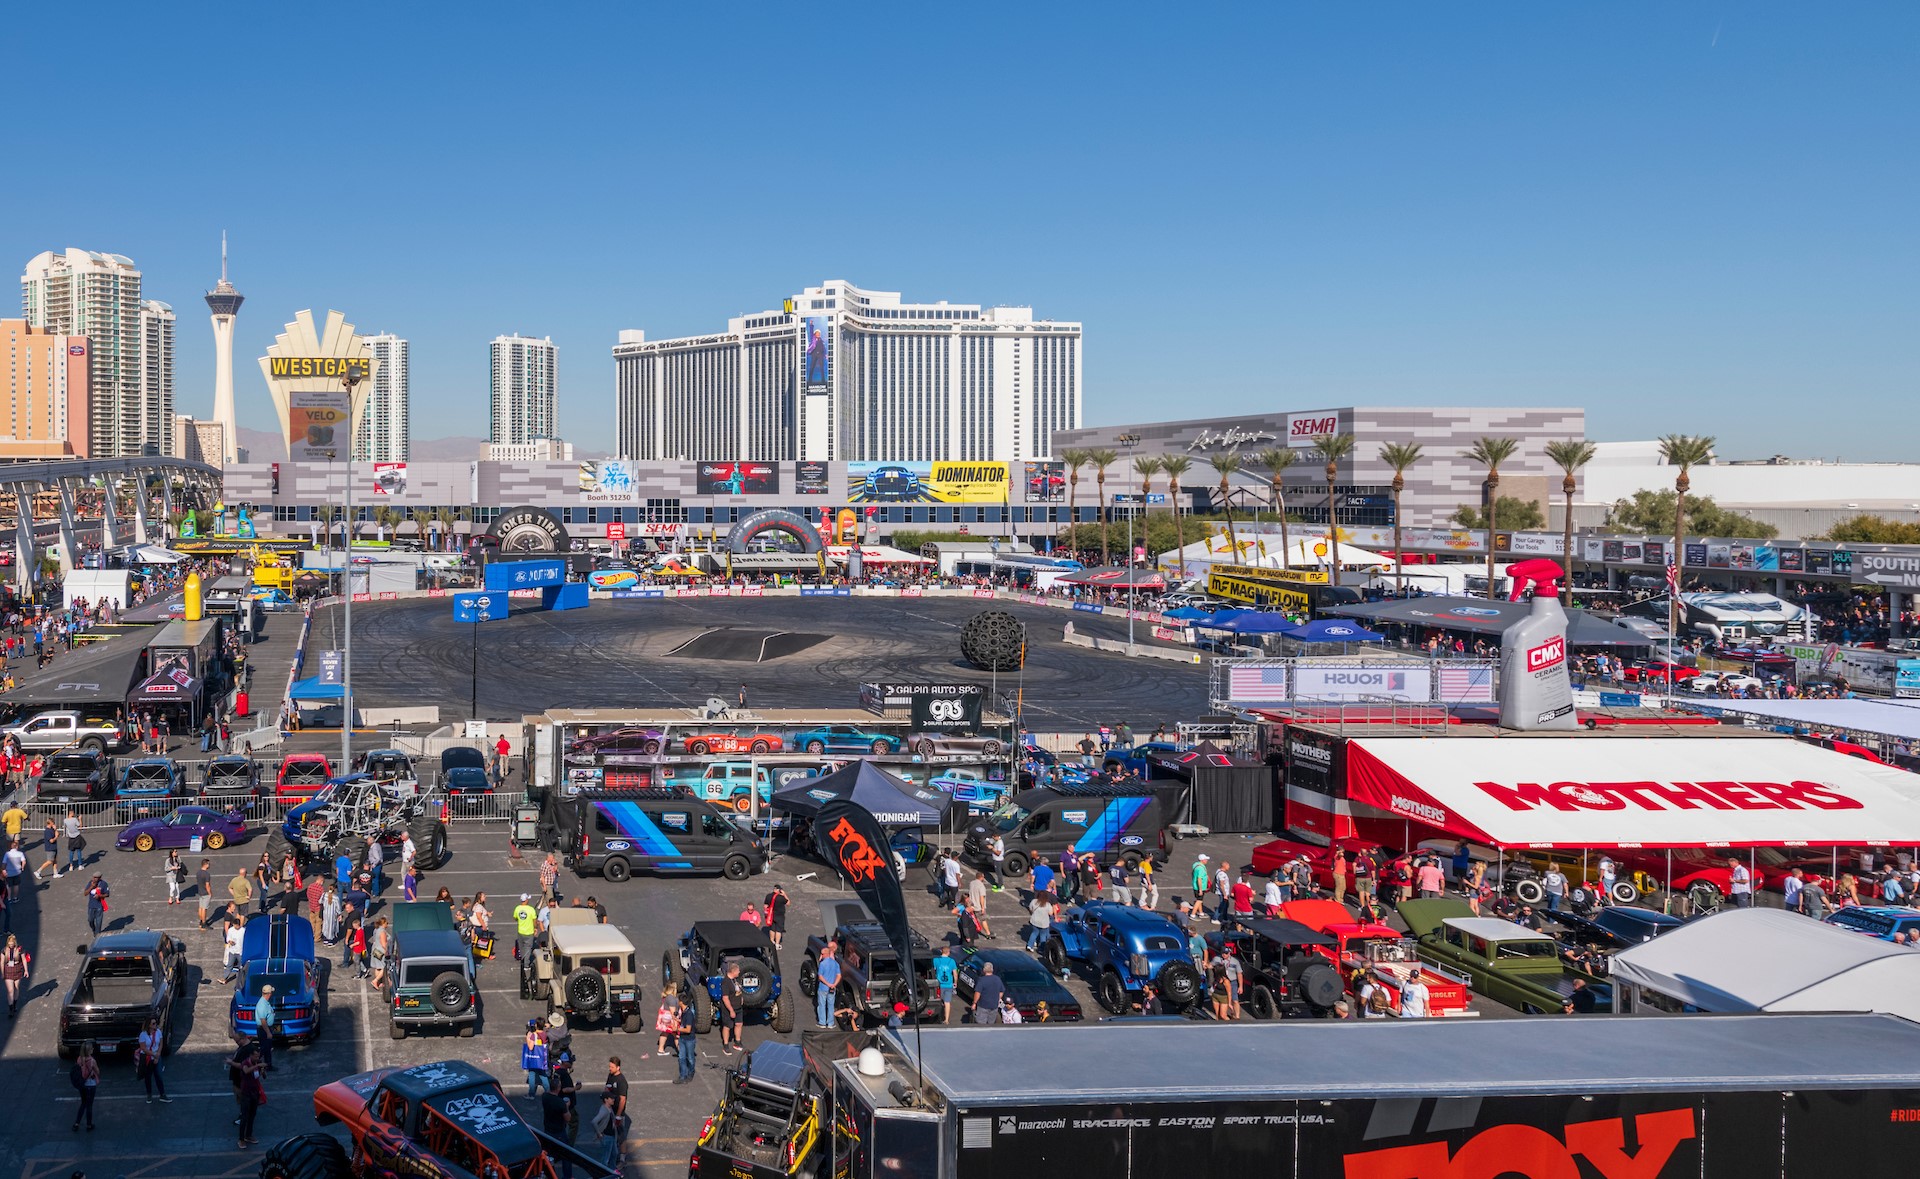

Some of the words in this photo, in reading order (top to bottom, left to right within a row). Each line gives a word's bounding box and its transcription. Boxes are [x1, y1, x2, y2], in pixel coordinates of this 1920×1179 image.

[784, 300, 793, 314] W
[306, 411, 336, 420] VELO
[1292, 417, 1336, 435] SEMA
[937, 467, 1004, 482] DOMINATOR
[498, 514, 532, 538] COKER
[536, 514, 561, 538] TIRE
[1863, 557, 1920, 569] SOUTH
[974, 590, 993, 598] SEMA
[1230, 584, 1306, 610] MAGNAFLOW
[1531, 642, 1561, 666] CMX
[326, 671, 334, 680] 2
[1535, 664, 1562, 678] CERAMIC
[896, 686, 929, 694] GALPIN
[932, 686, 956, 694] AUTO
[1539, 711, 1555, 724] PRO
[725, 741, 736, 750] 68
[1292, 742, 1331, 760] MOTHERS
[1161, 760, 1179, 771] ROUSH
[707, 785, 722, 793] 66
[1473, 780, 1864, 811] MOTHERS
[1392, 794, 1445, 822] MOTHERS
[829, 816, 886, 883] FOX
[476, 1120, 517, 1135] Unlimited
[1018, 1119, 1066, 1130] marzocchi
[1080, 1119, 1151, 1128] RACEFACE
[1158, 1117, 1216, 1126] EASTON
[1224, 1116, 1261, 1125] SPORT
[1264, 1116, 1298, 1124] TRUCK
[1300, 1116, 1323, 1124] USA
